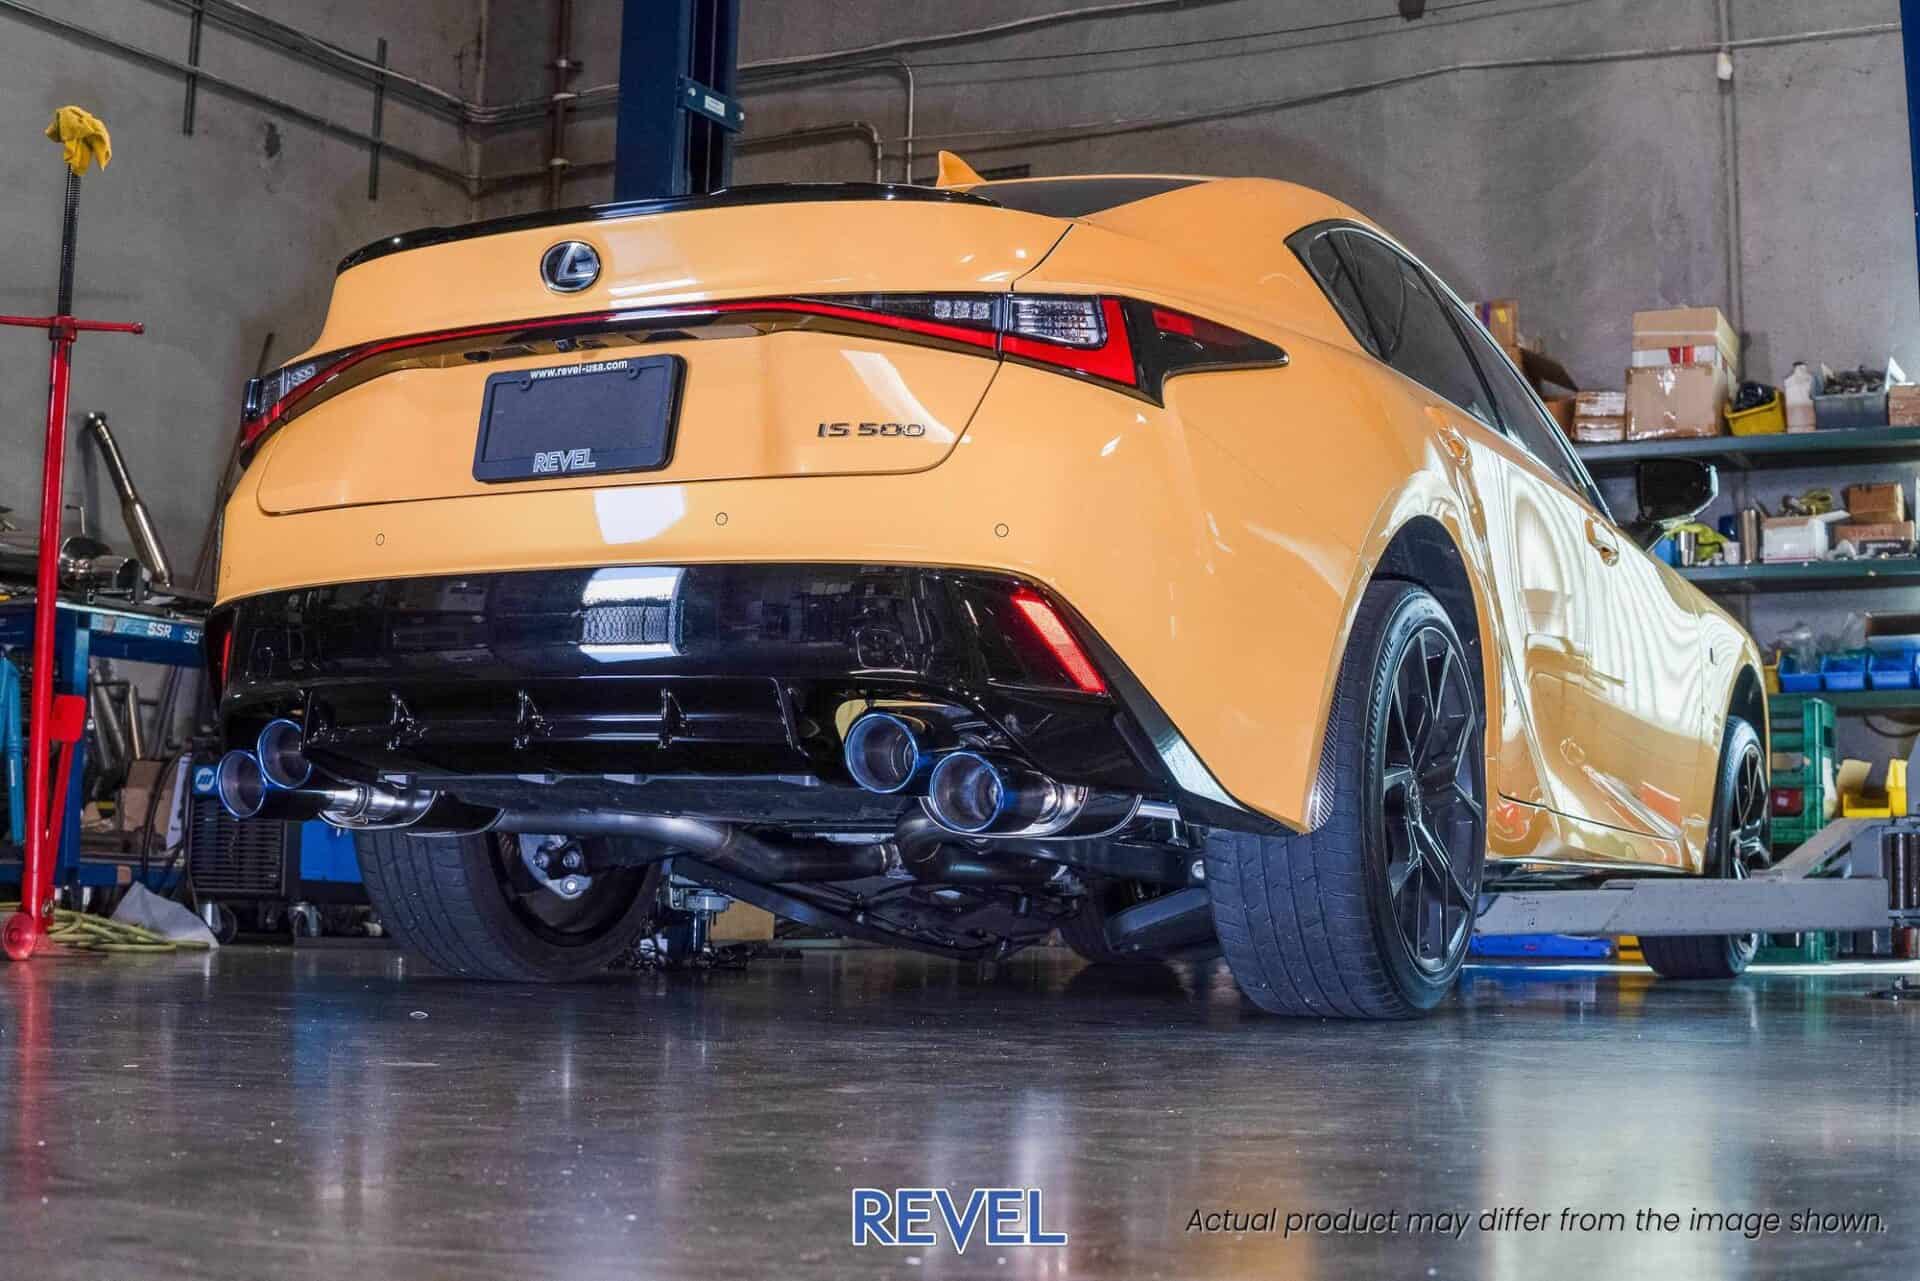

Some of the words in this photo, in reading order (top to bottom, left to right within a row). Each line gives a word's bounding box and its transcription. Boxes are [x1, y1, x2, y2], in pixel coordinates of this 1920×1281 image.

[529, 360, 628, 380] www.revel-usa.com
[816, 422, 850, 438] IS
[857, 422, 926, 438] 500
[532, 448, 596, 473] REVEL
[147, 622, 173, 639] SSR
